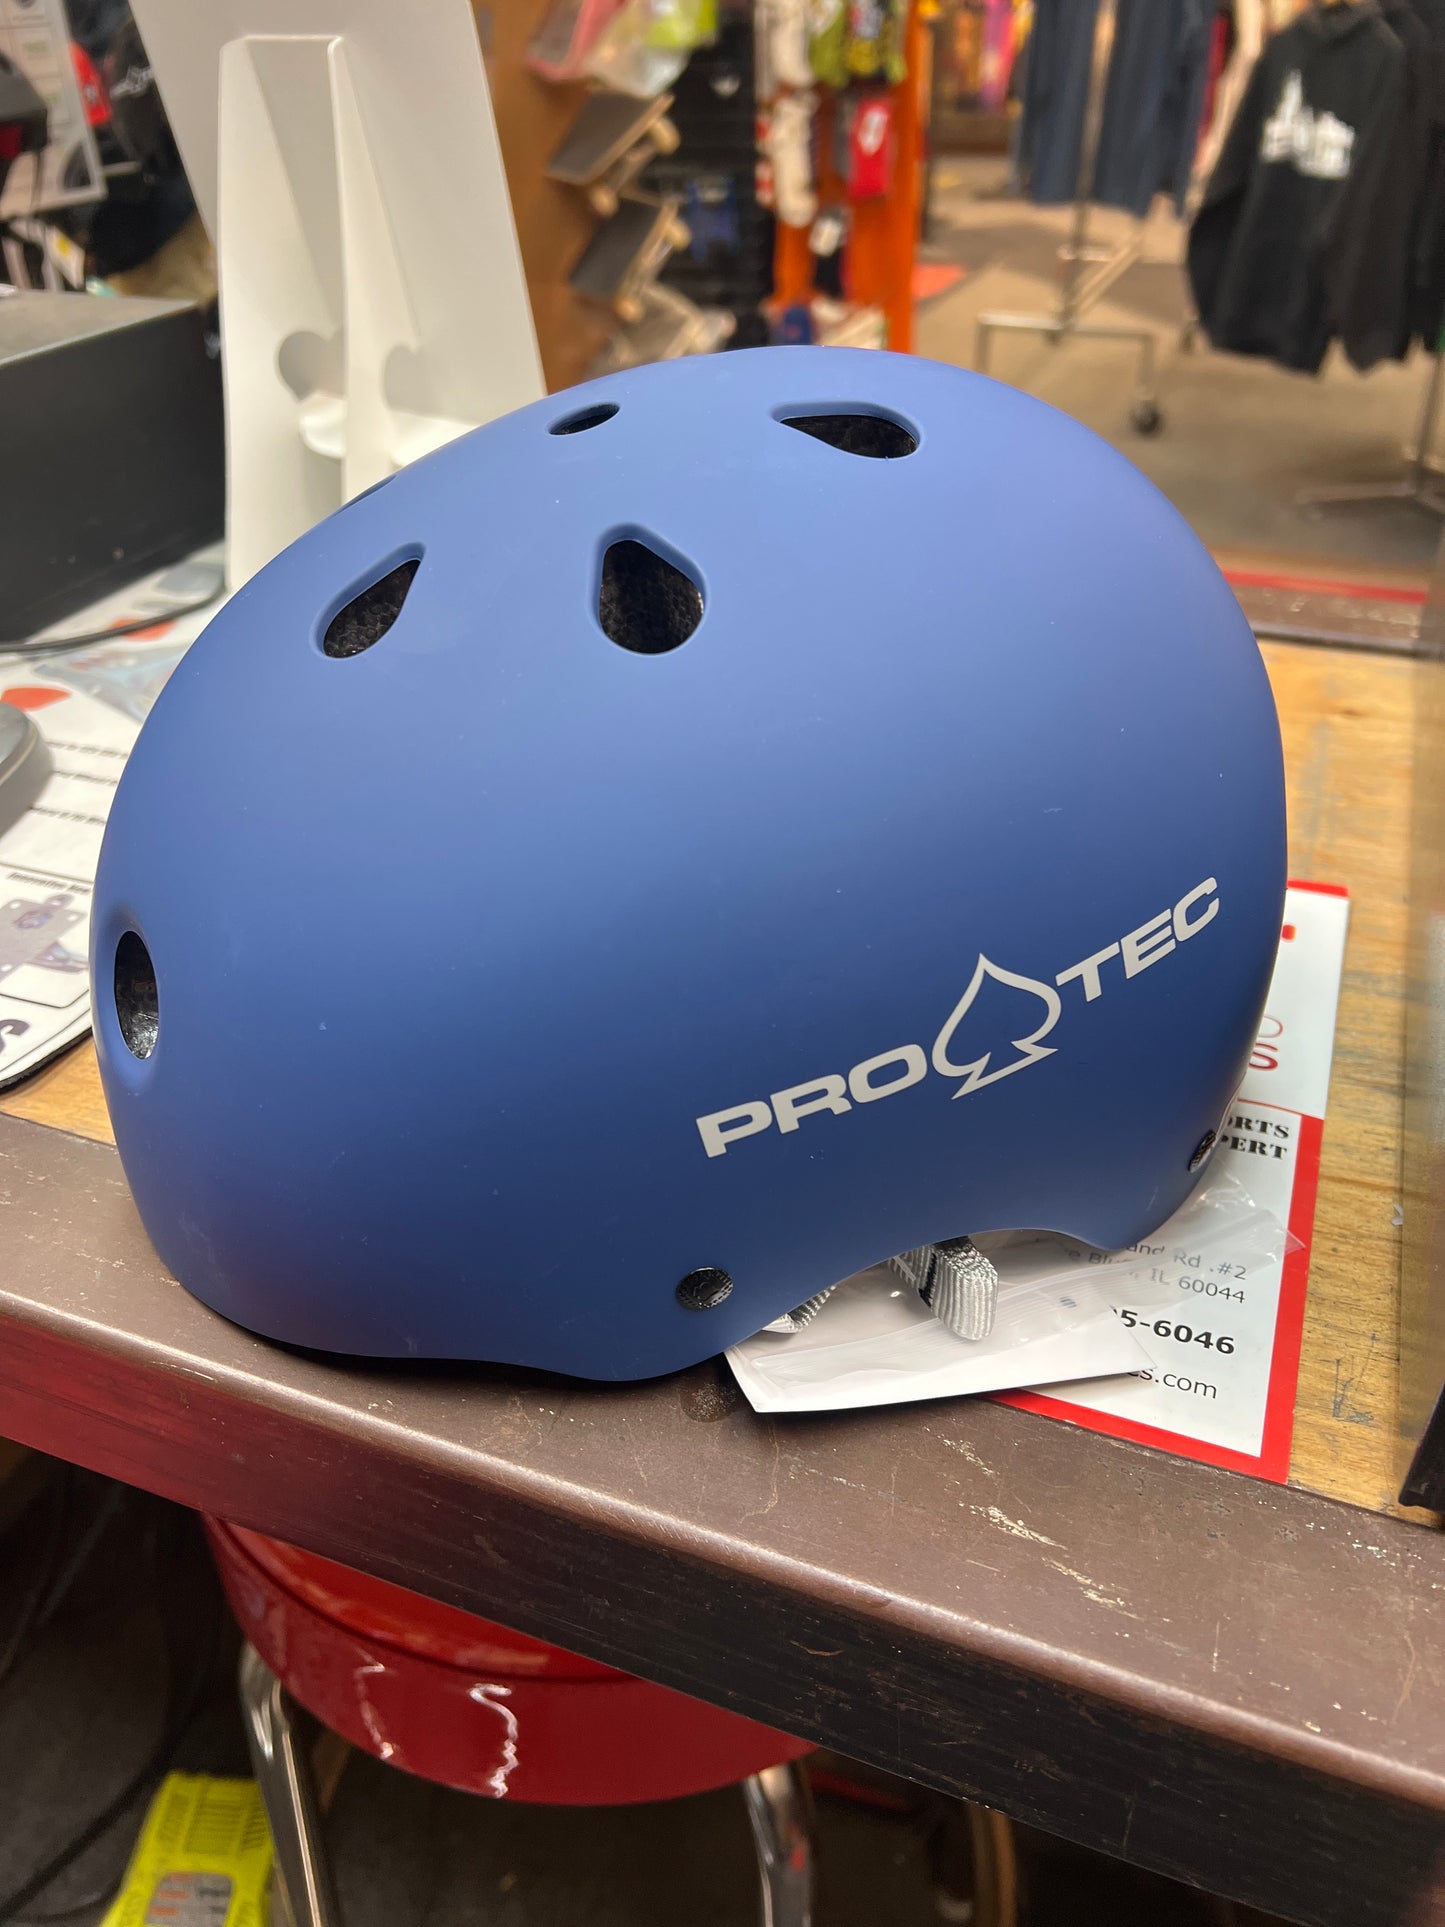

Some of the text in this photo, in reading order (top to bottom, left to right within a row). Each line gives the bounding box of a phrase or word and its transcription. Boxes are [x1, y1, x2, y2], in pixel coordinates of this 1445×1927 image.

[696, 877, 1220, 1158] PRO TEC
[1228, 1115, 1290, 1139] RTS
[1173, 1249, 1201, 1268] Rd
[1178, 1275, 1245, 1304] 60044
[1111, 1305, 1236, 1355] 5-6046
